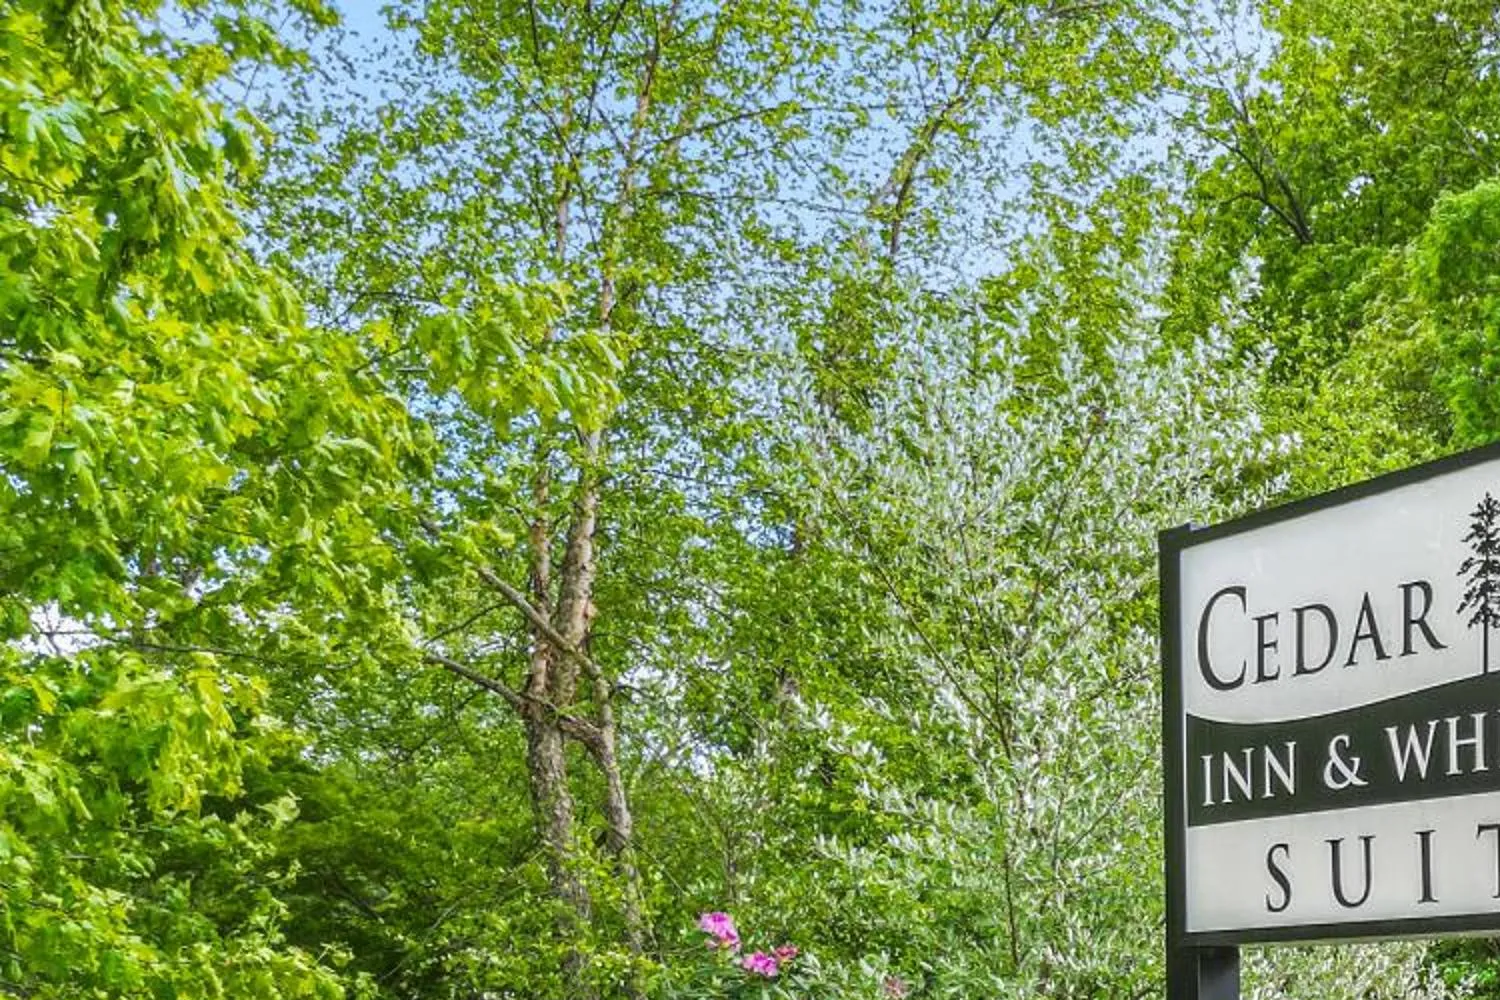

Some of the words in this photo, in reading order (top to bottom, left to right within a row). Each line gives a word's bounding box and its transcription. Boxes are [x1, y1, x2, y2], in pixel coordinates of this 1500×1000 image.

[1196, 580, 1448, 691] CEDAR
[1200, 740, 1297, 808] INN
[1322, 734, 1368, 791] &
